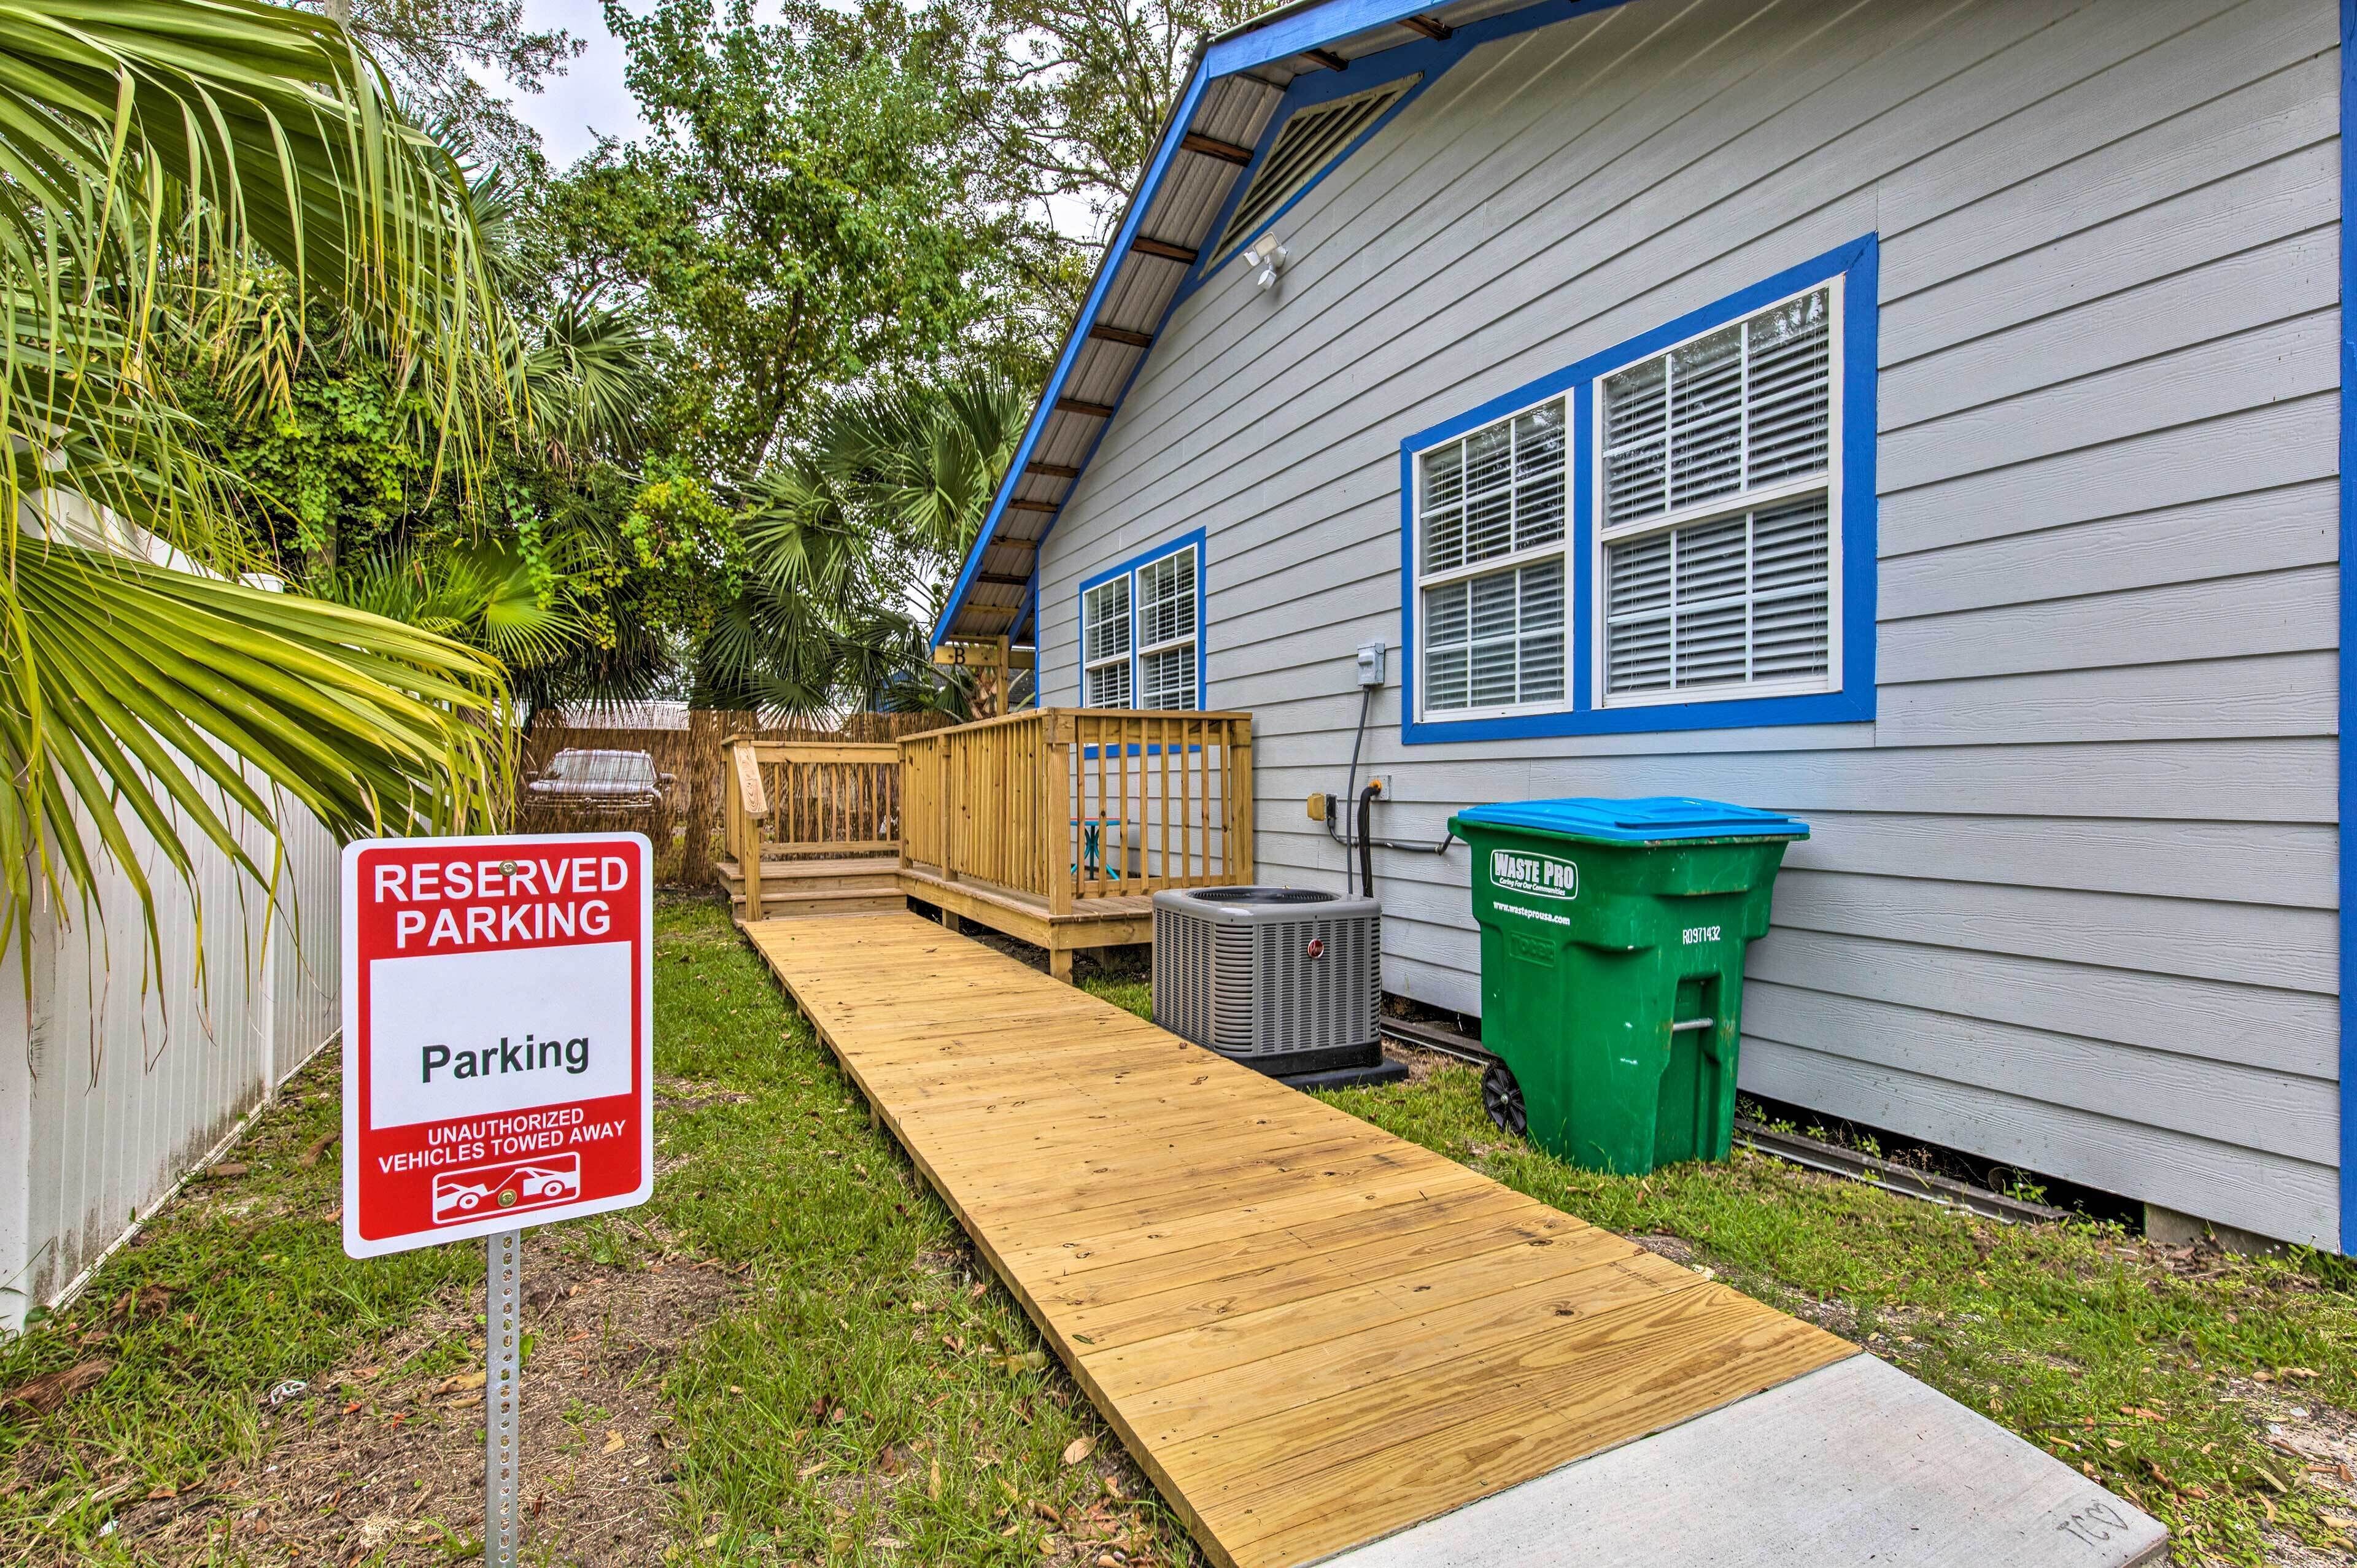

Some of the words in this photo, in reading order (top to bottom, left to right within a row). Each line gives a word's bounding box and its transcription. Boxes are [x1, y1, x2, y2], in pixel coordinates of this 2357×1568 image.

[954, 647, 966, 664] B
[374, 857, 628, 903] RESERVED
[1495, 852, 1539, 883] WASTE
[1544, 860, 1574, 889] PRO
[1500, 877, 1514, 887] Caring
[1532, 884, 1566, 896] Communities
[397, 900, 610, 949] PARKING
[1493, 902, 1570, 925] www.wasteprousa.com
[422, 1035, 589, 1083] Parking
[428, 1108, 584, 1146] UNAUTHORIZED
[378, 1141, 485, 1173] VEHICLES
[491, 1130, 564, 1156] TOWED
[569, 1120, 626, 1145] AWAY
